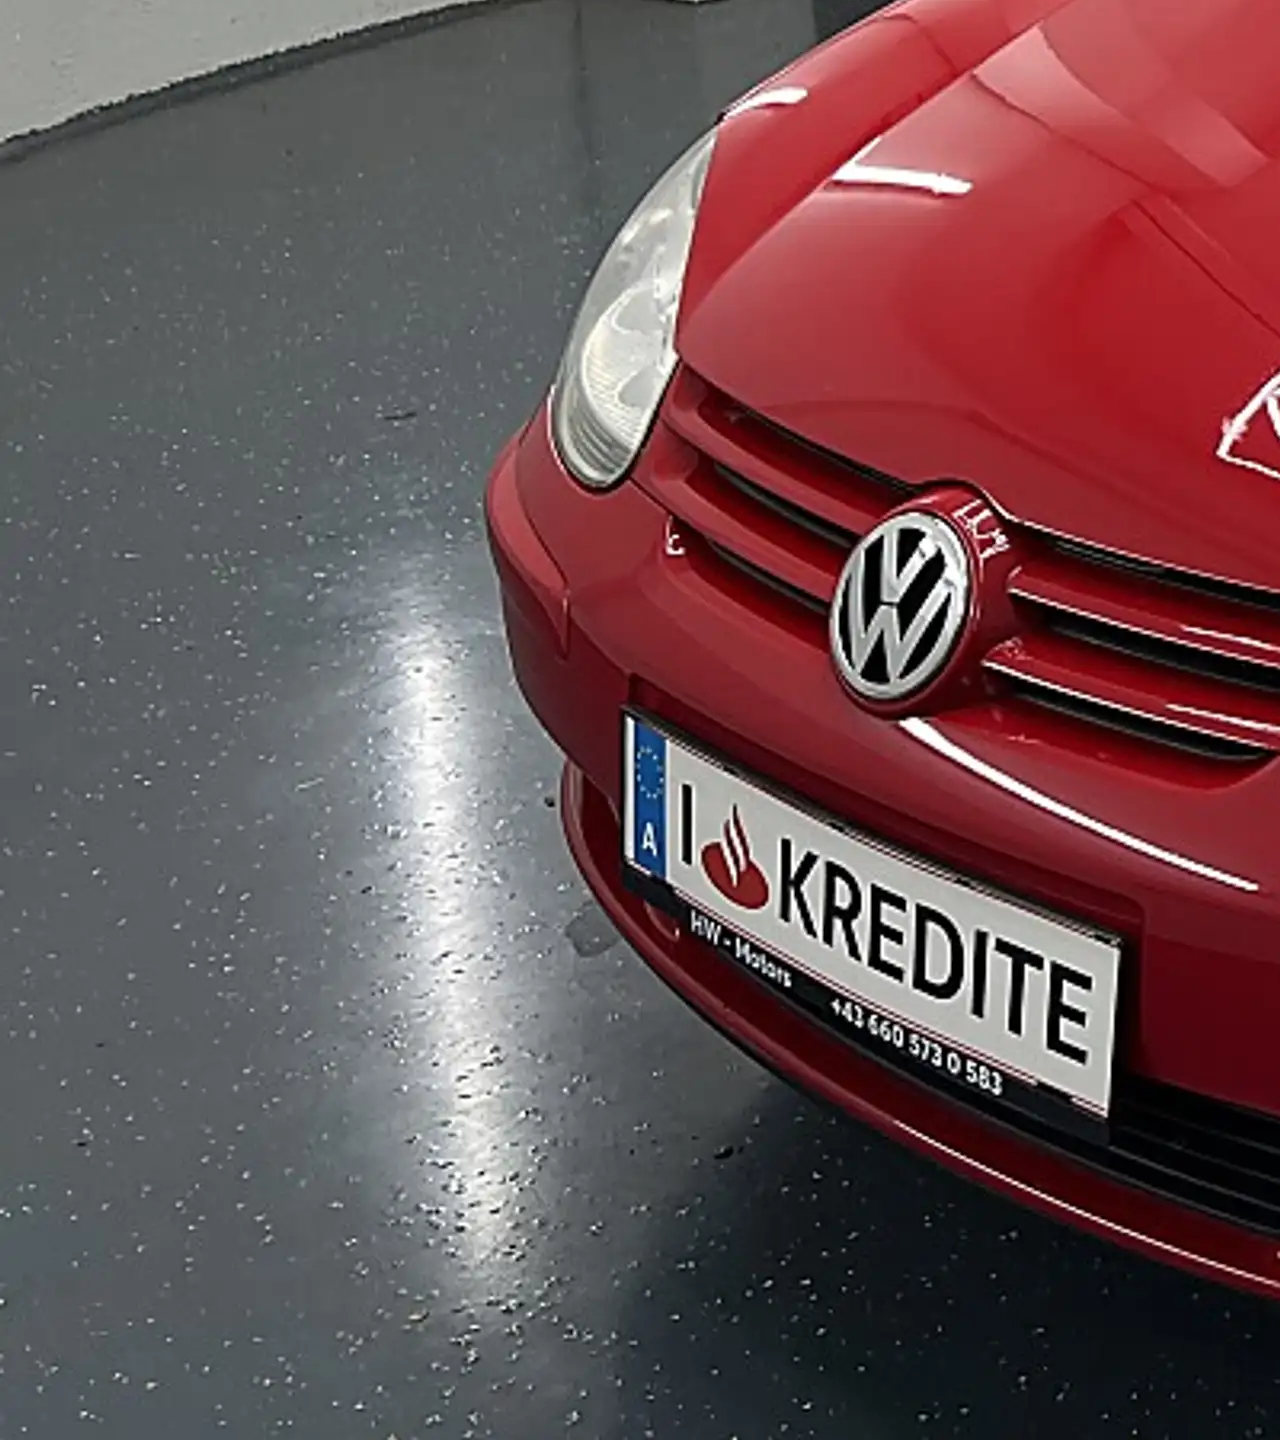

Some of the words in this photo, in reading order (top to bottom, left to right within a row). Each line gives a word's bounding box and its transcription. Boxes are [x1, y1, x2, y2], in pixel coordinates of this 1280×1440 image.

[845, 524, 958, 682] VW
[642, 822, 657, 853] A
[691, 911, 722, 947] HW
[735, 937, 792, 988] Motors
[778, 837, 1094, 1065] KREDITE
[831, 997, 864, 1029] +43
[868, 1014, 903, 1048] 660
[908, 1034, 943, 1071] 573
[967, 1066, 1003, 1096] 583
